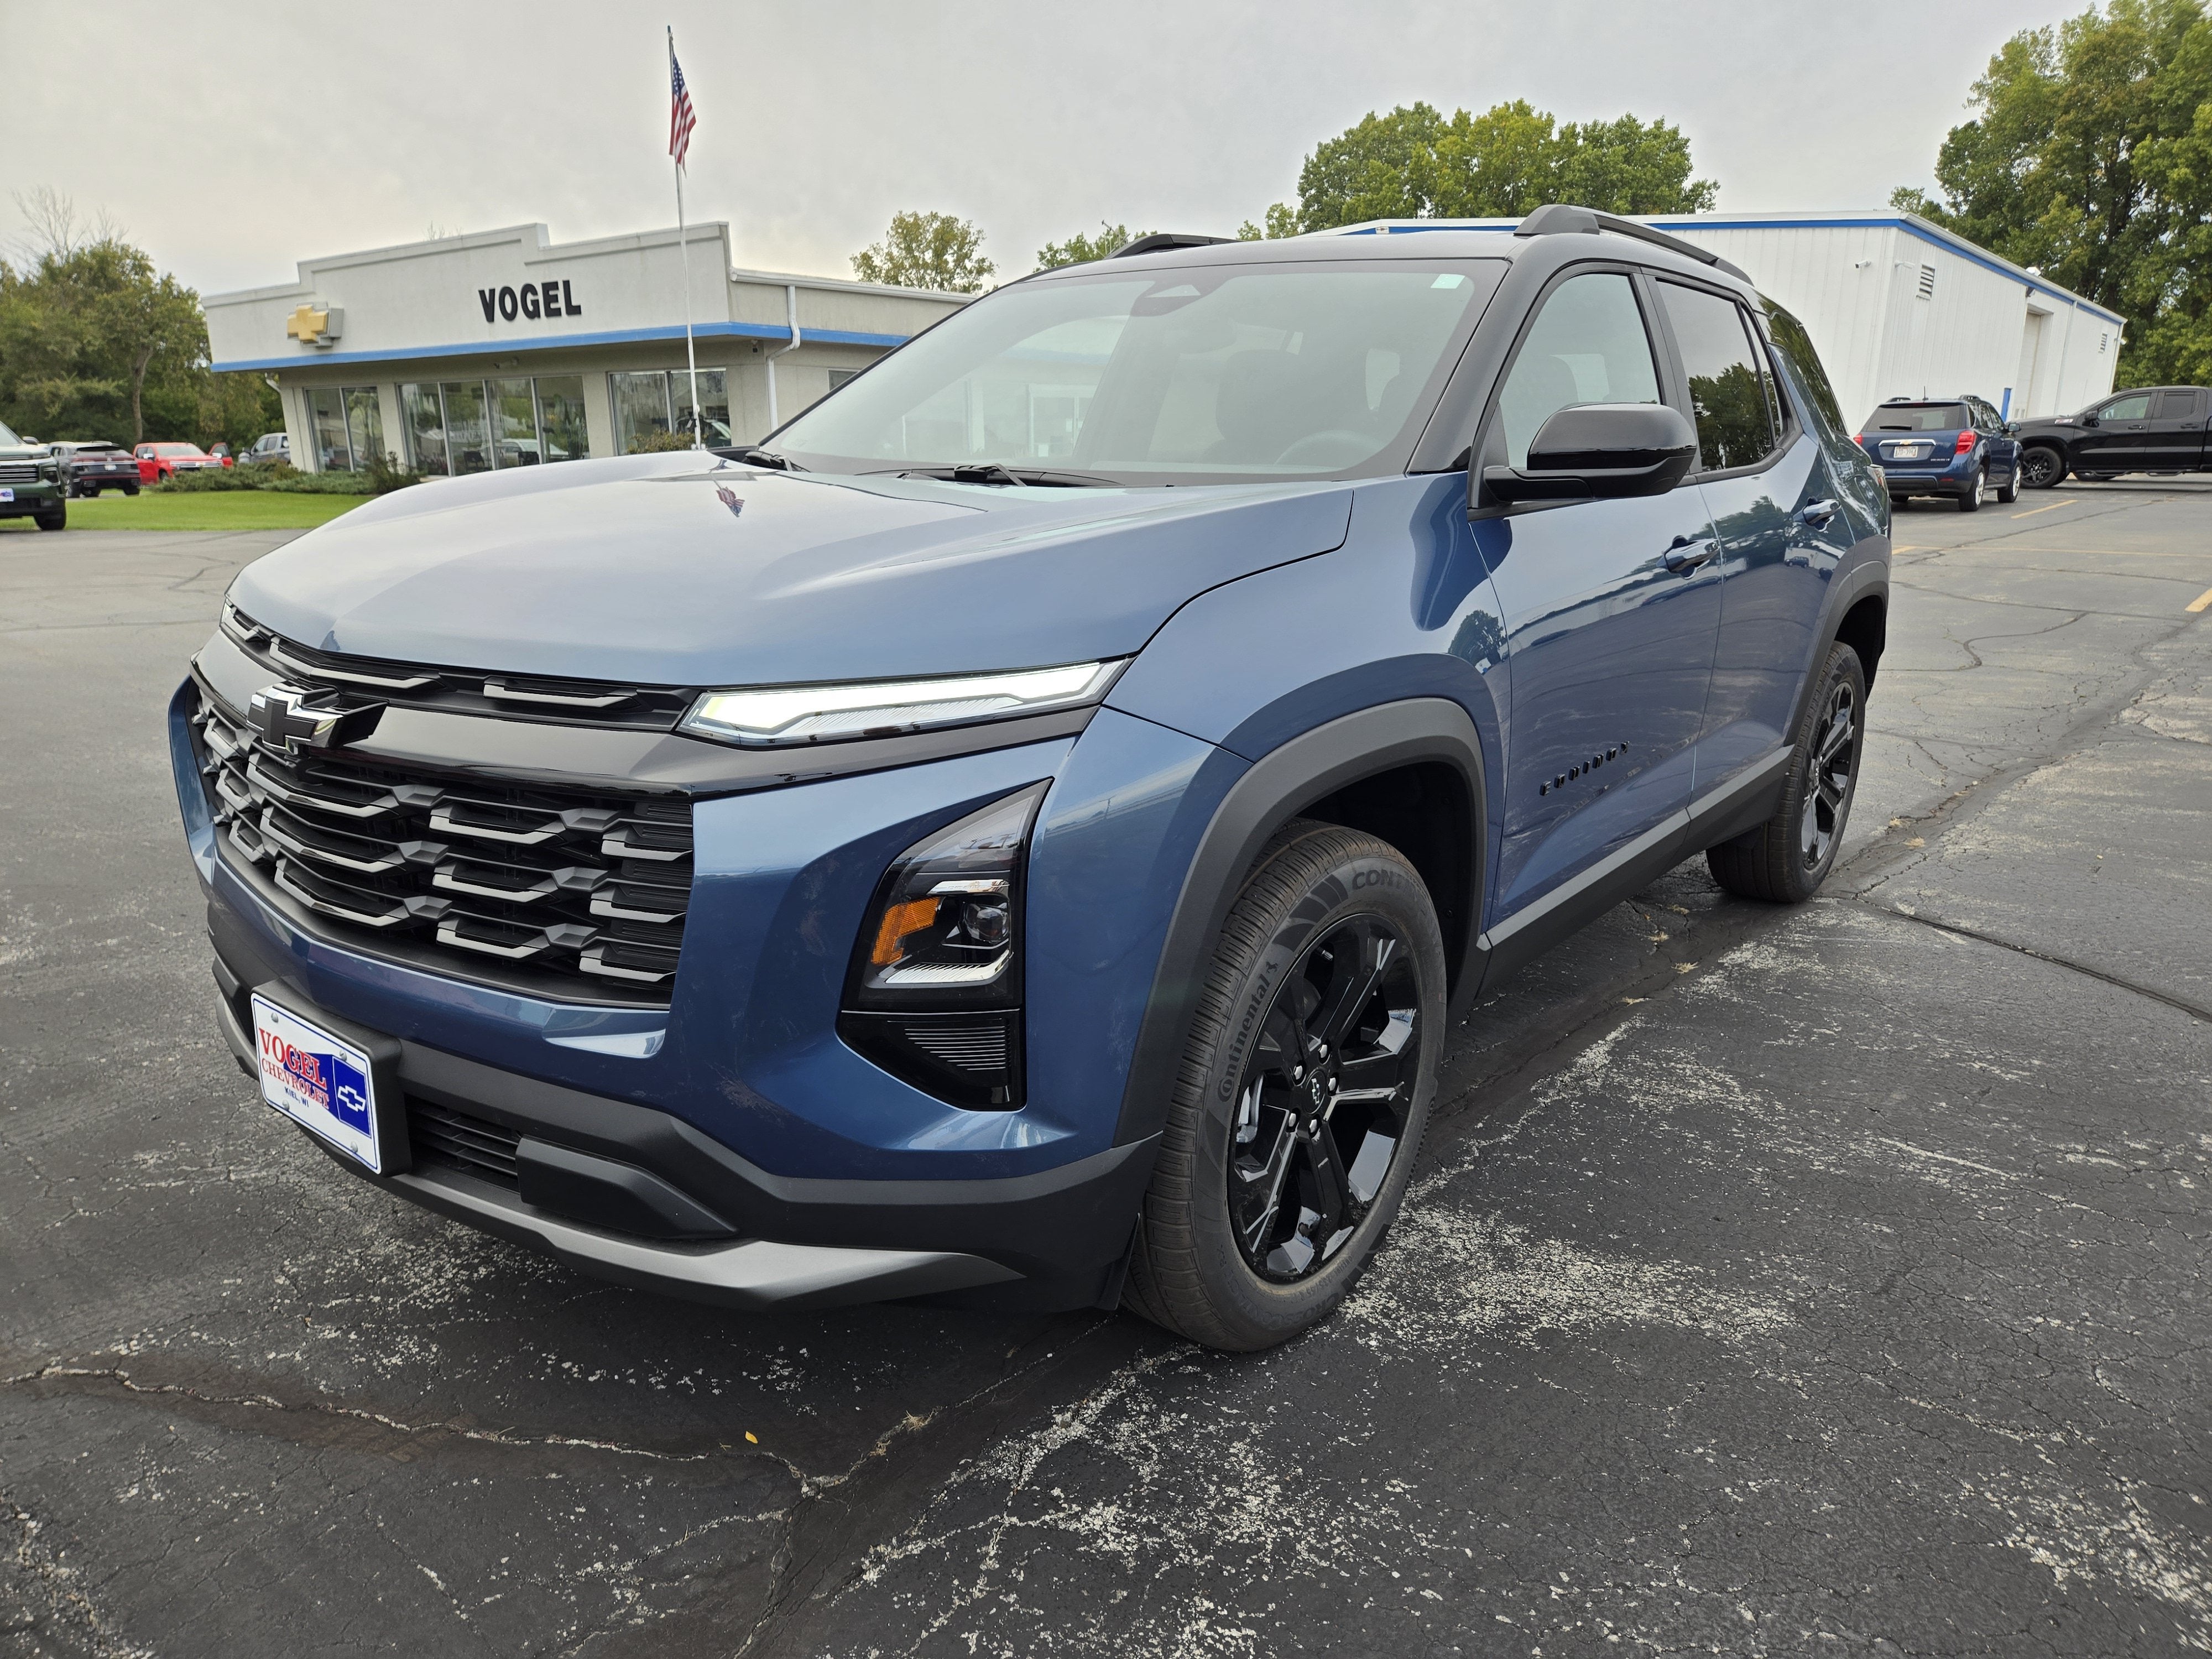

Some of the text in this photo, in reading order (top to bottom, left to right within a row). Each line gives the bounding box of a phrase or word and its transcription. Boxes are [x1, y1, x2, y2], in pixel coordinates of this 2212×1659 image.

[478, 279, 582, 322] VOGEL
[259, 1027, 326, 1089] VOGEL
[1217, 973, 1271, 1102] Continental
[262, 1058, 330, 1109] CHEVROLET
[285, 1087, 310, 1108] KIEL, WI
